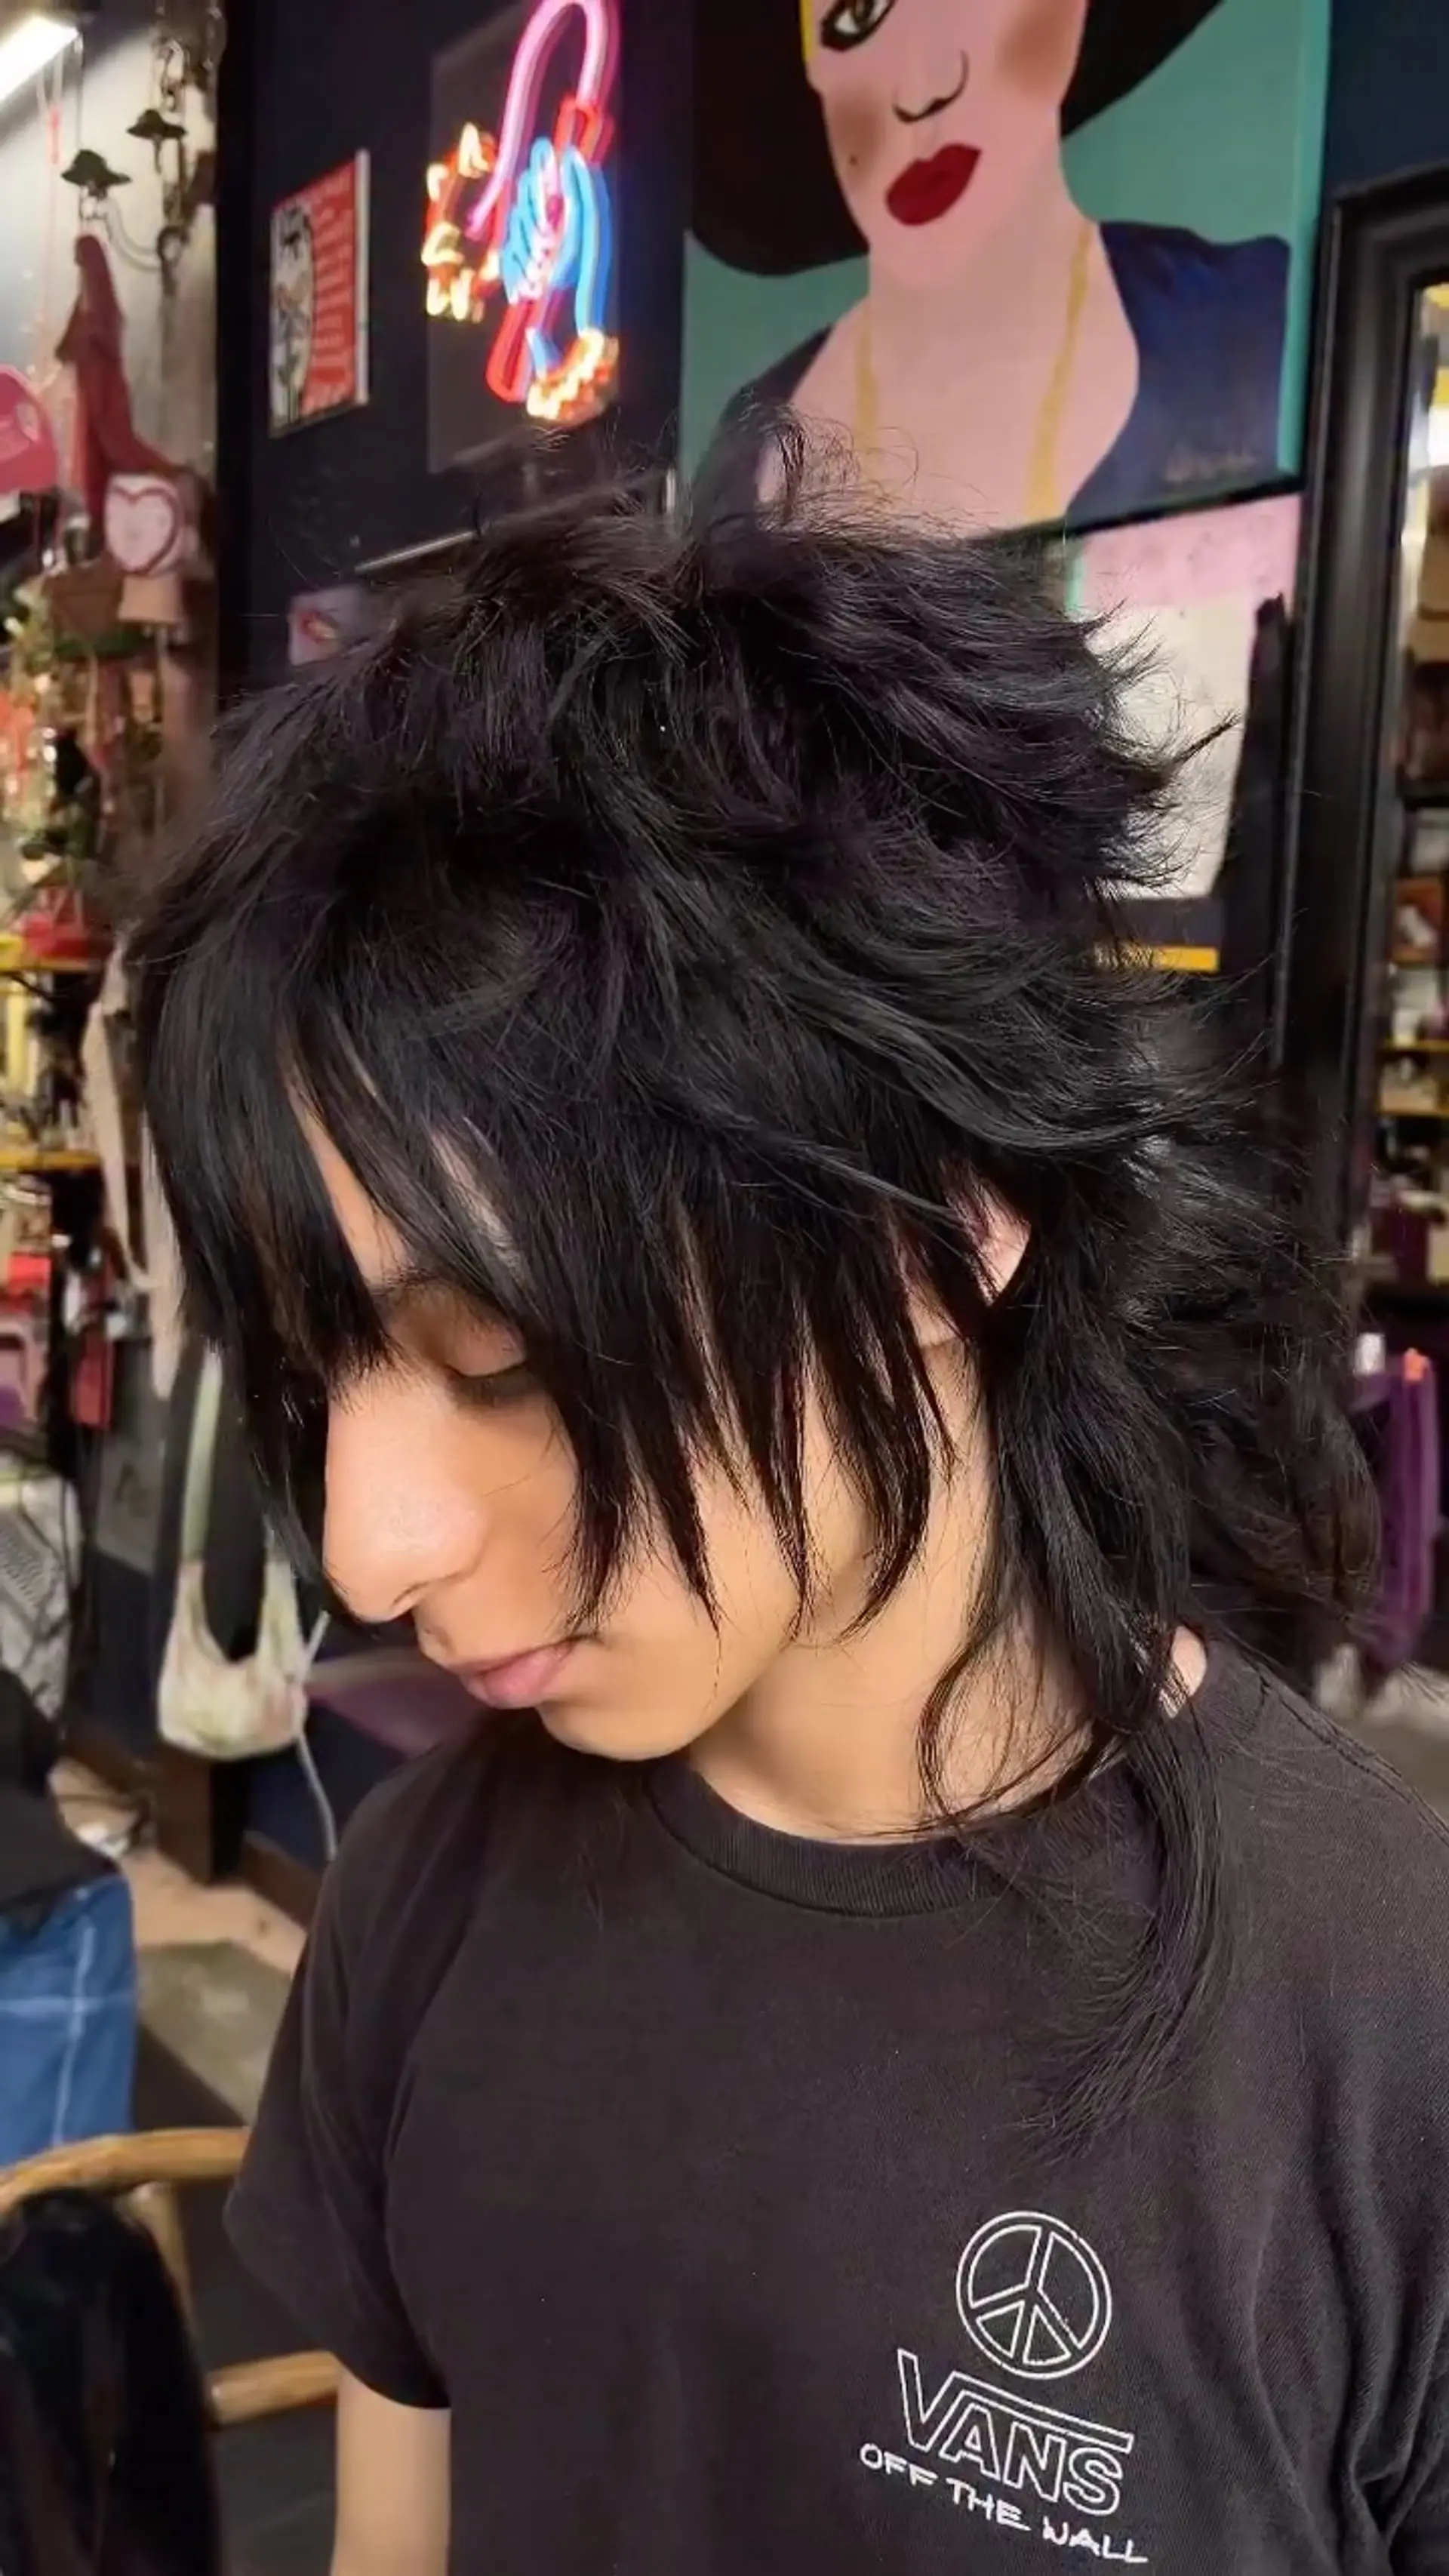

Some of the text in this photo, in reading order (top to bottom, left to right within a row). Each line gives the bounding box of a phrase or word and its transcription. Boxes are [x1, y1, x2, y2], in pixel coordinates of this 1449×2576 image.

[860, 2443, 1149, 2564] OFF THE WALL
[897, 2347, 1134, 2516] VANS
